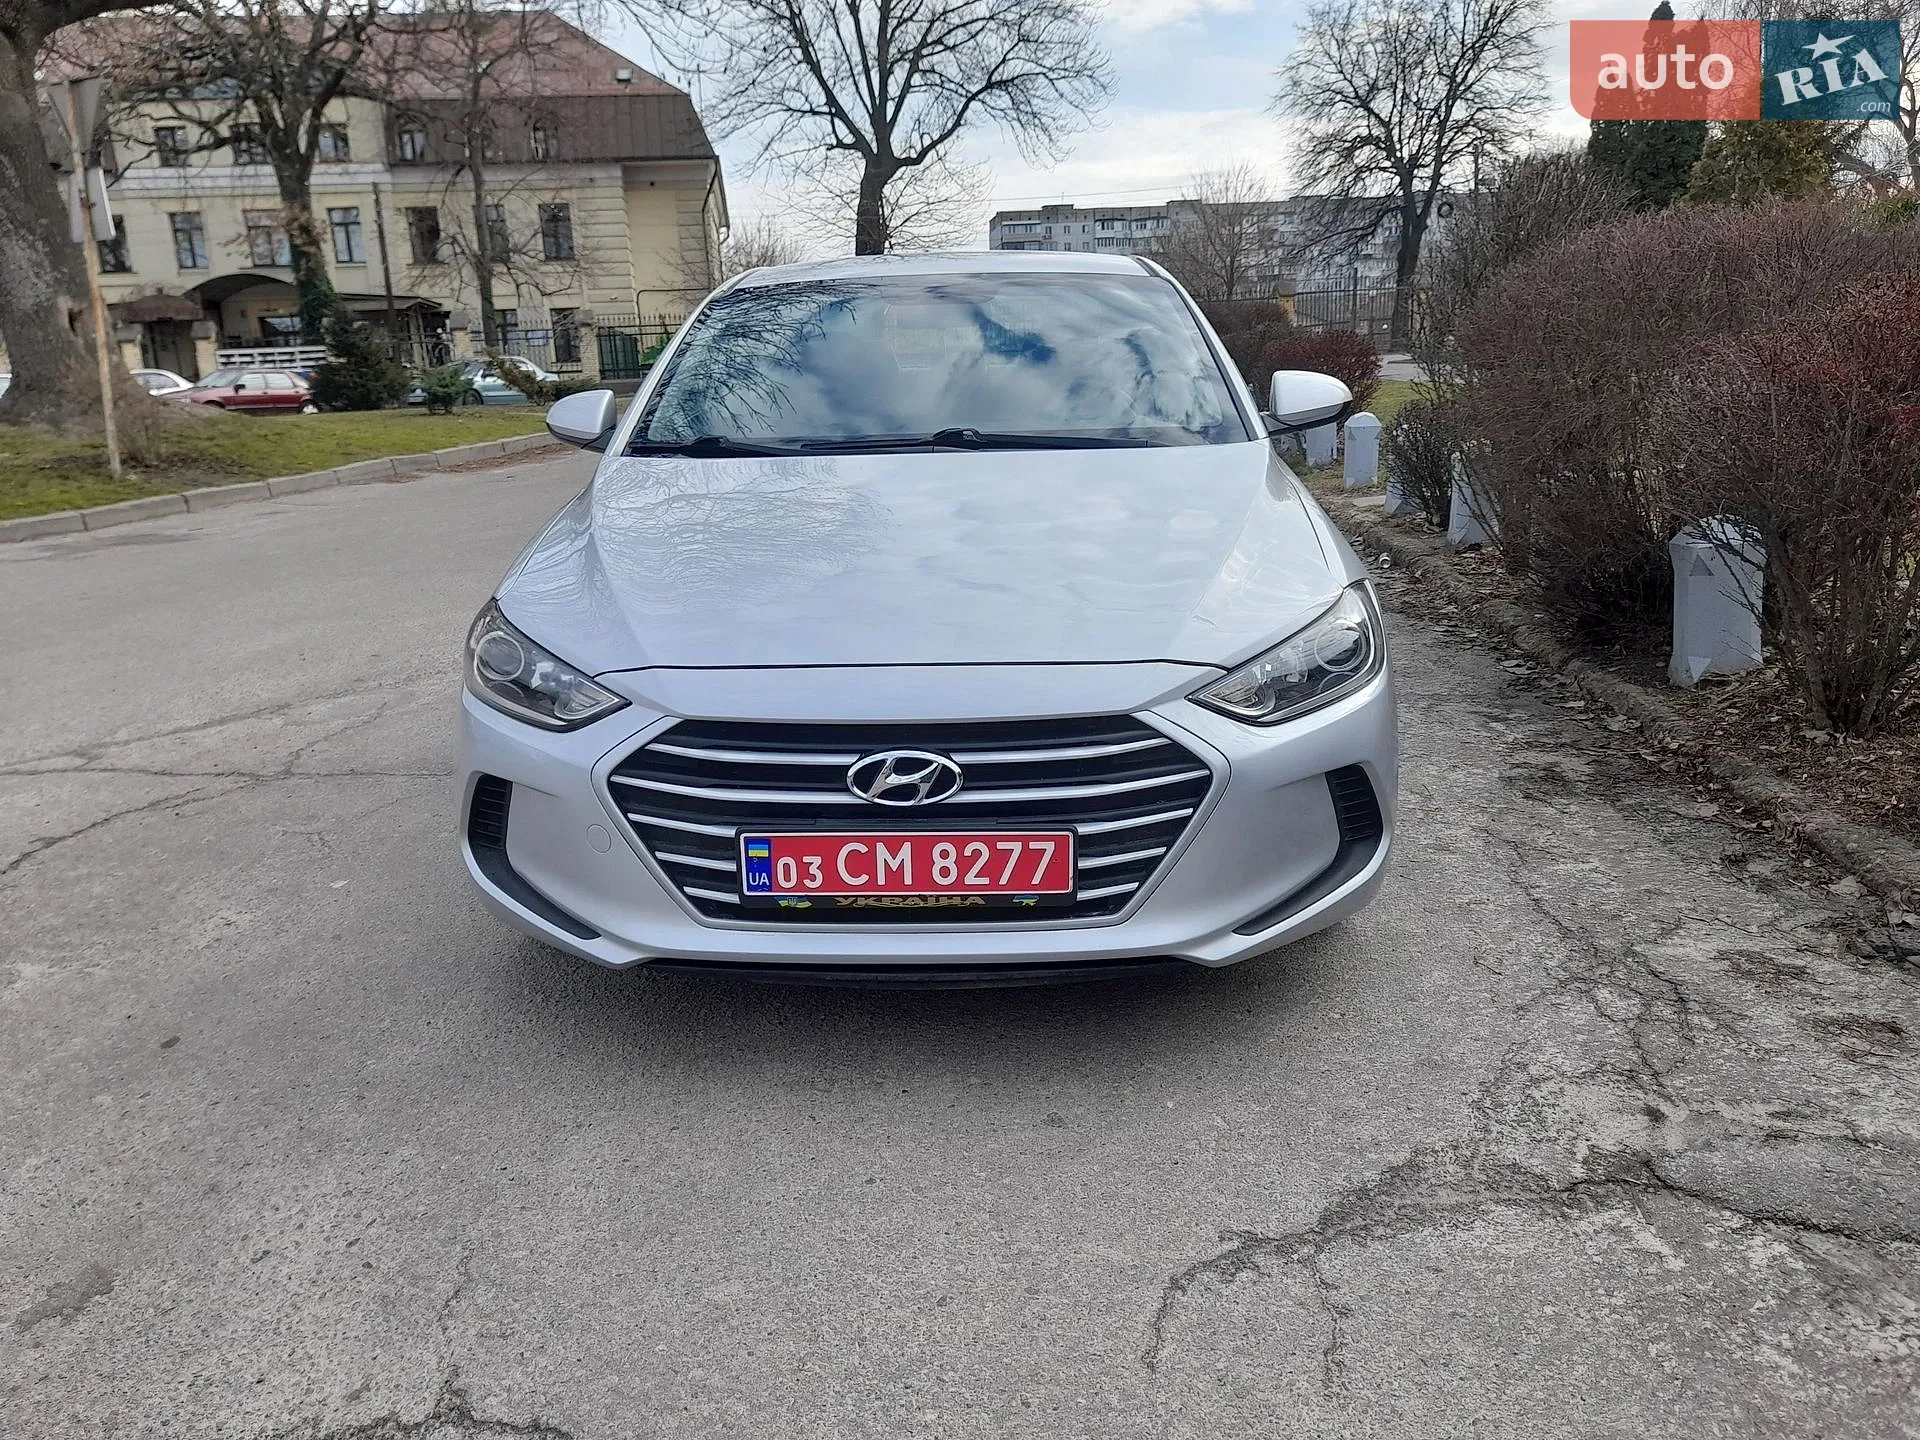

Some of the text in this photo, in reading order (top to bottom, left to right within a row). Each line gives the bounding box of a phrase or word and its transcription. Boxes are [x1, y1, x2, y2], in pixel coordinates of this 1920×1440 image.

[776, 841, 1055, 889] 03 CM 8277
[749, 872, 770, 886] UA
[834, 895, 986, 908] УКРАЇНА
